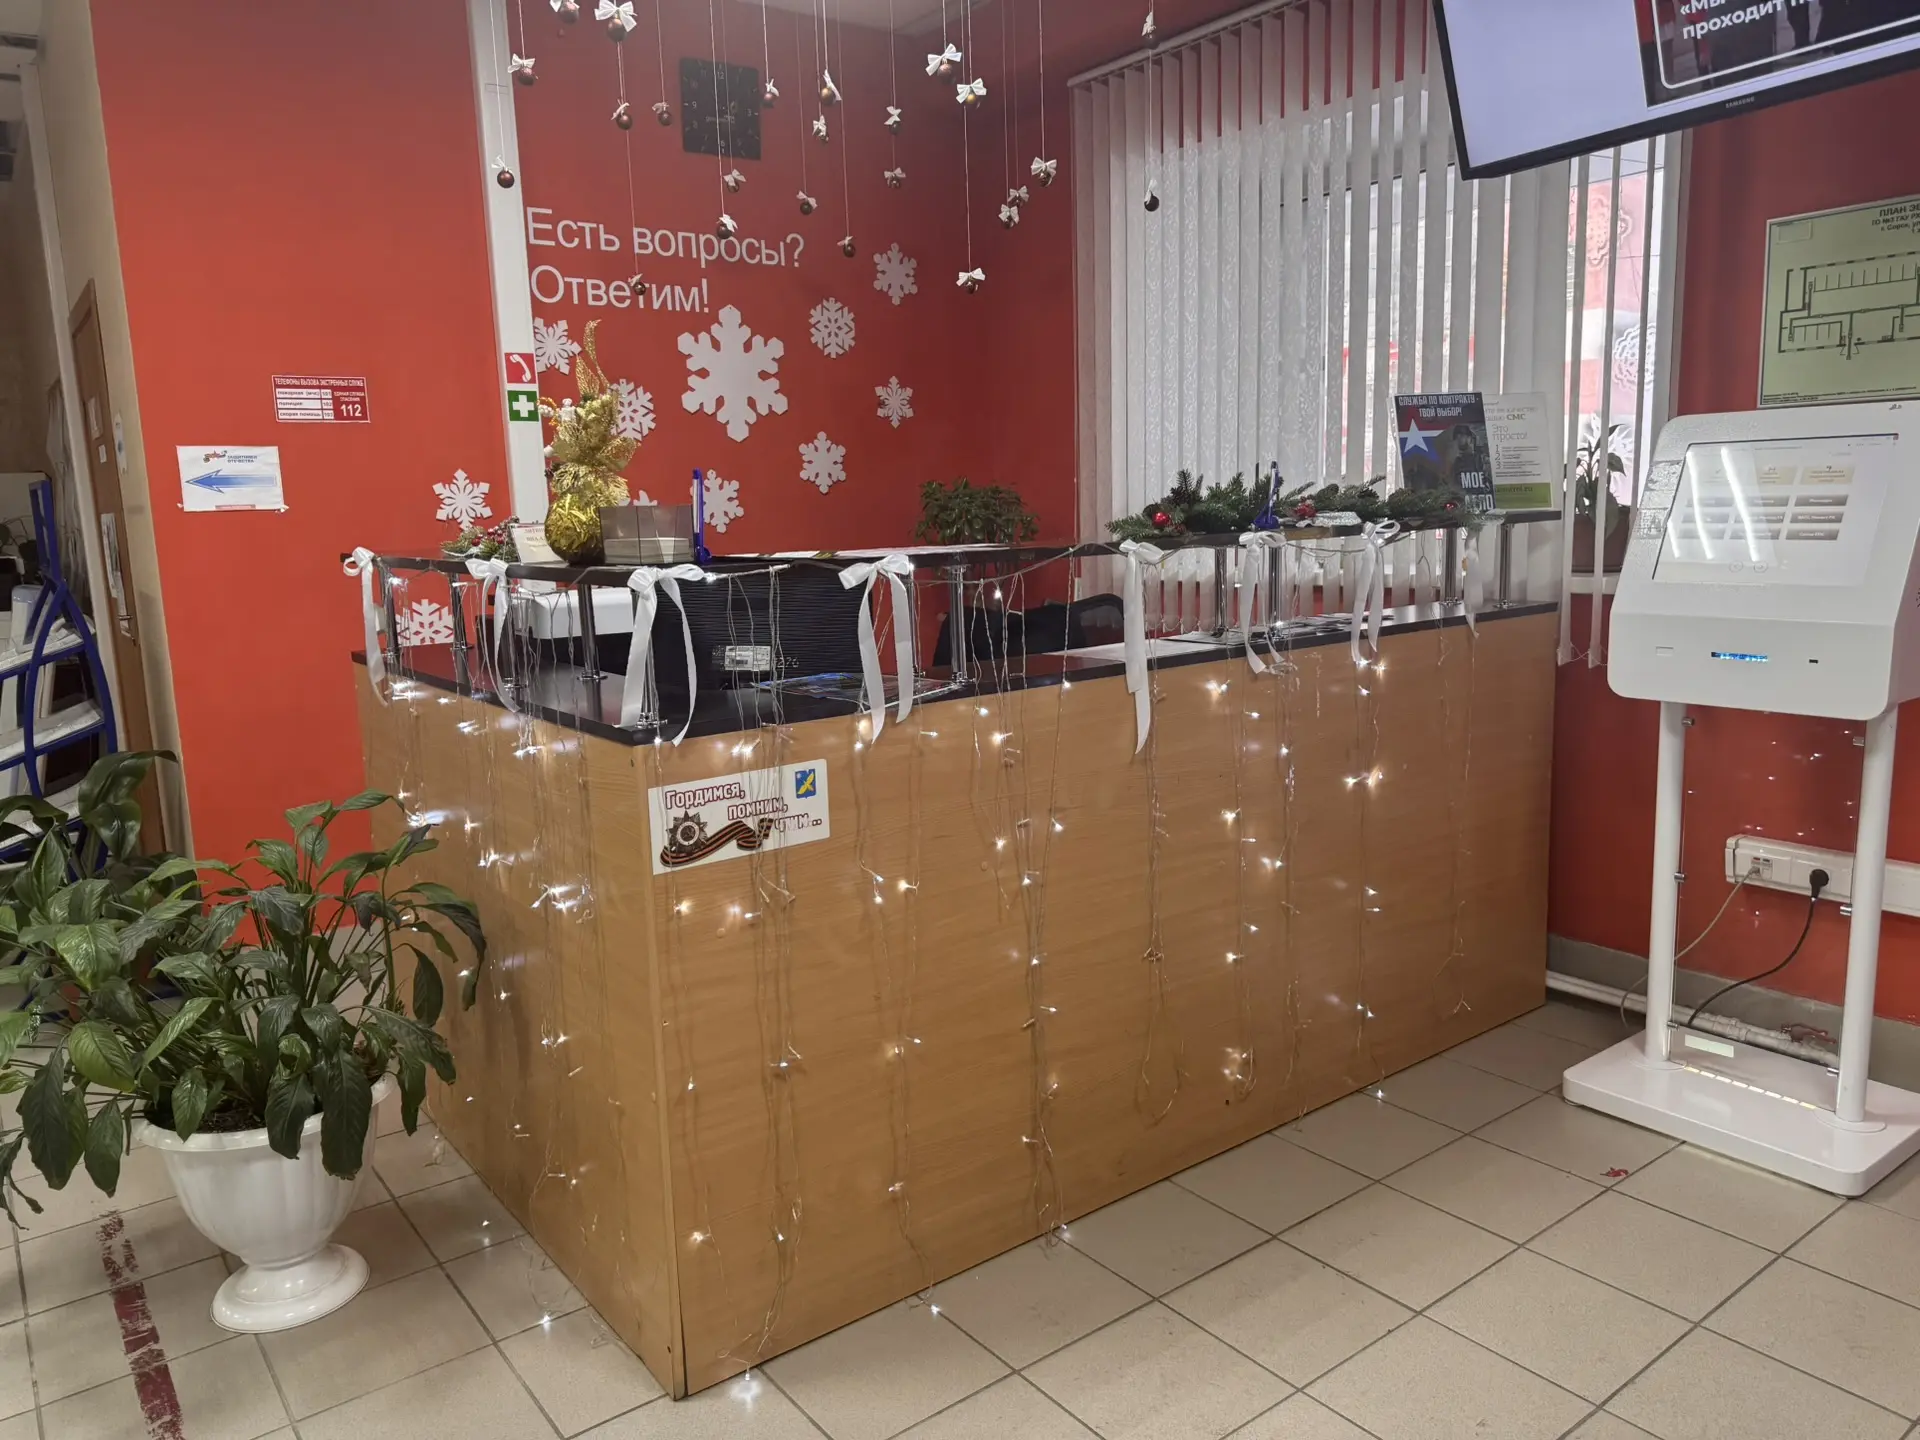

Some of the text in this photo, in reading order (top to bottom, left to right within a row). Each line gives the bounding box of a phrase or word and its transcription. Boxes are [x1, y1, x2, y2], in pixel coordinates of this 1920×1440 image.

[1682, 0, 1783, 39] проходит
[1880, 206, 1906, 217] ПЛАН
[526, 206, 805, 269] Есть вопросы?
[530, 264, 710, 314] Ответим!
[1399, 396, 1428, 406] СЛУЖБА
[1428, 395, 1438, 405] ПО
[1438, 394, 1476, 404] КОНТРАКТУ
[340, 403, 363, 417] 112
[1418, 406, 1463, 417] ТВОЙ ВЫБОР!
[1491, 423, 1509, 433] Это
[1491, 431, 1528, 443] просто!
[665, 782, 746, 810] Гордимся,
[727, 796, 789, 821] помним,
